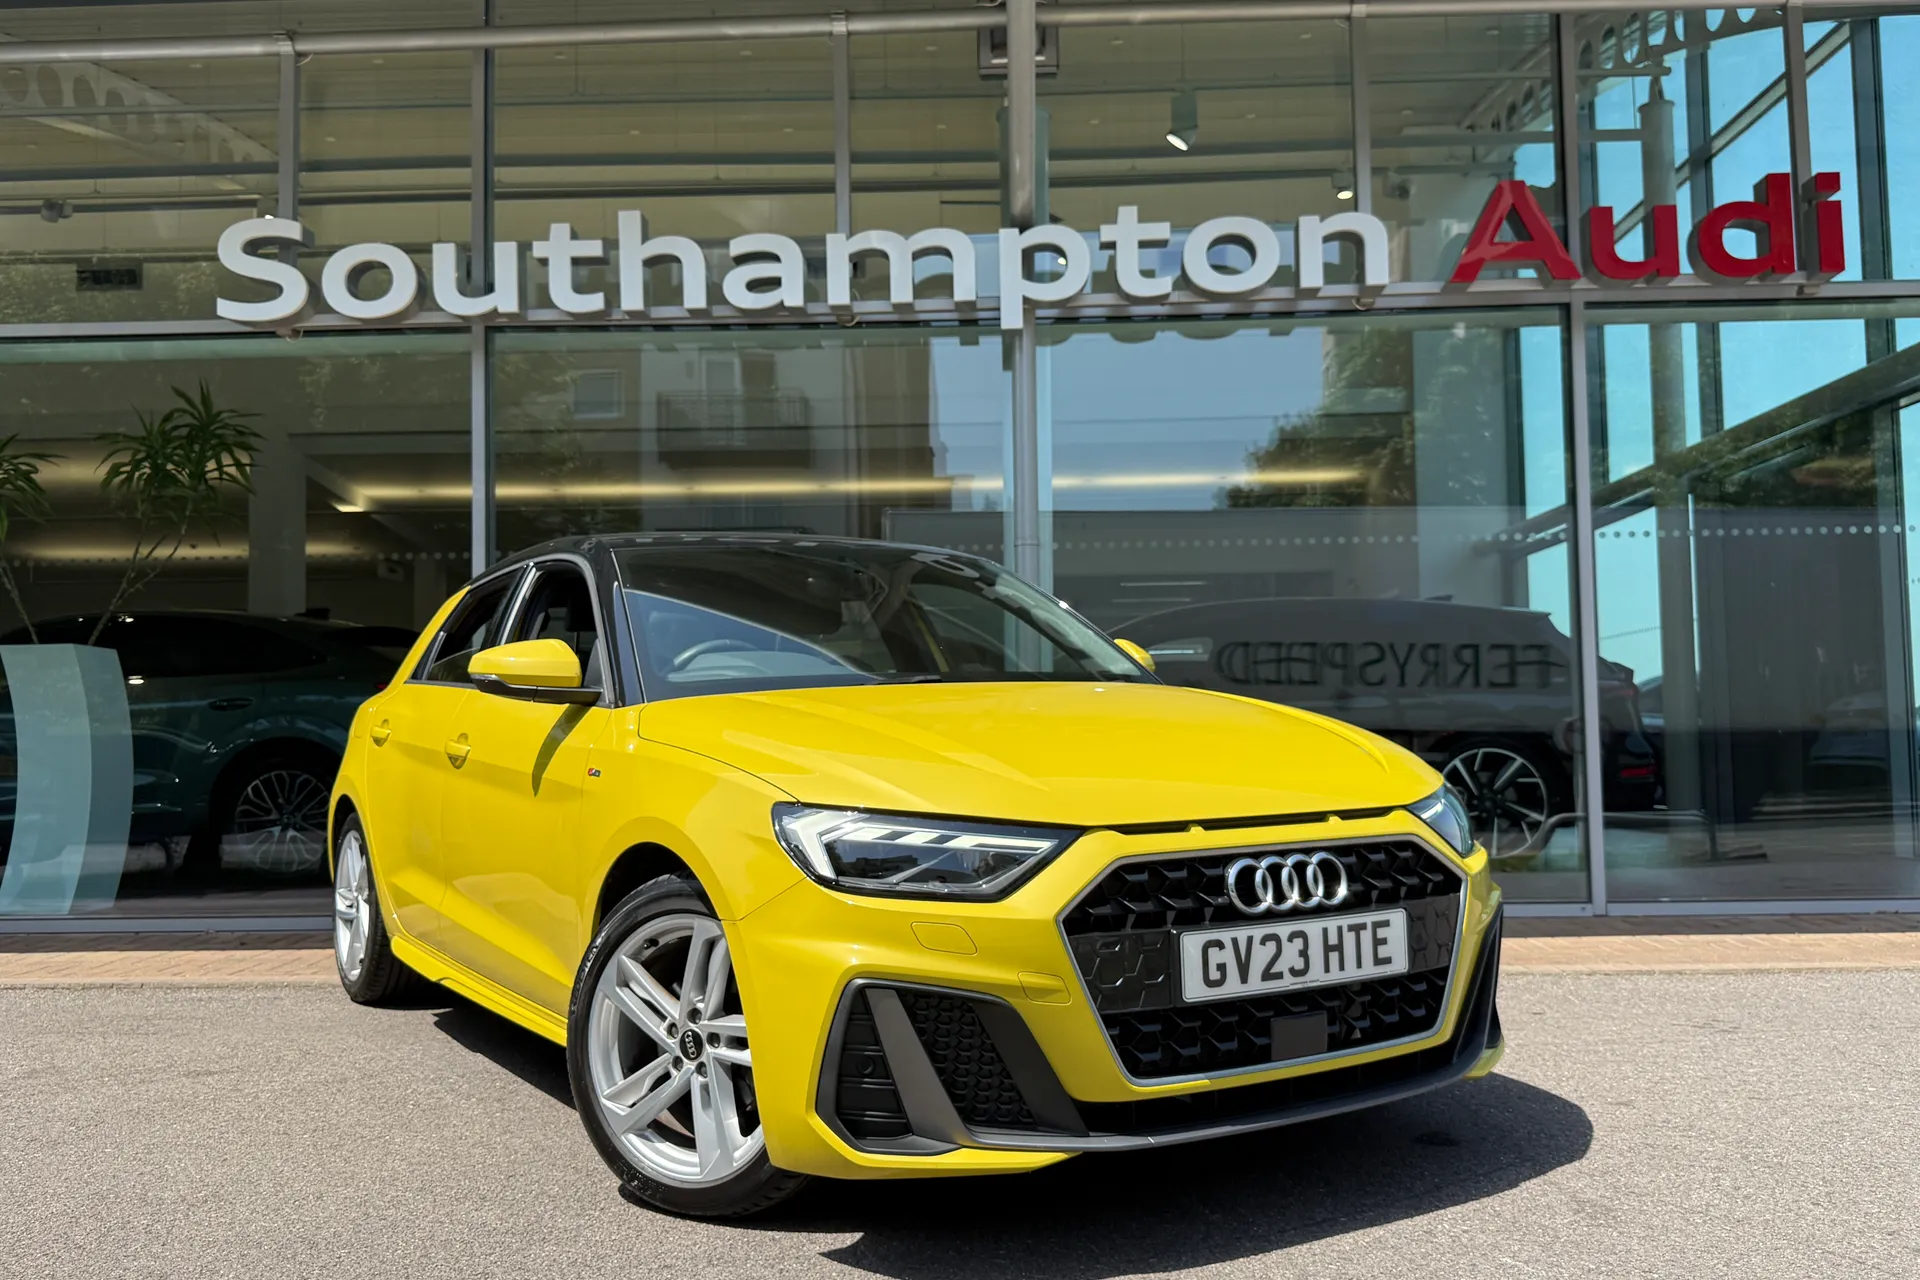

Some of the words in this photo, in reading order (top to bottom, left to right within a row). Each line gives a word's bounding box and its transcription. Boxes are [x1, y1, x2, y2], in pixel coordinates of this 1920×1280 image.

[216, 205, 1389, 330] Southampton
[1450, 171, 1845, 284] Audi
[1200, 929, 1311, 989] GV23
[1321, 918, 1393, 974] HTE
